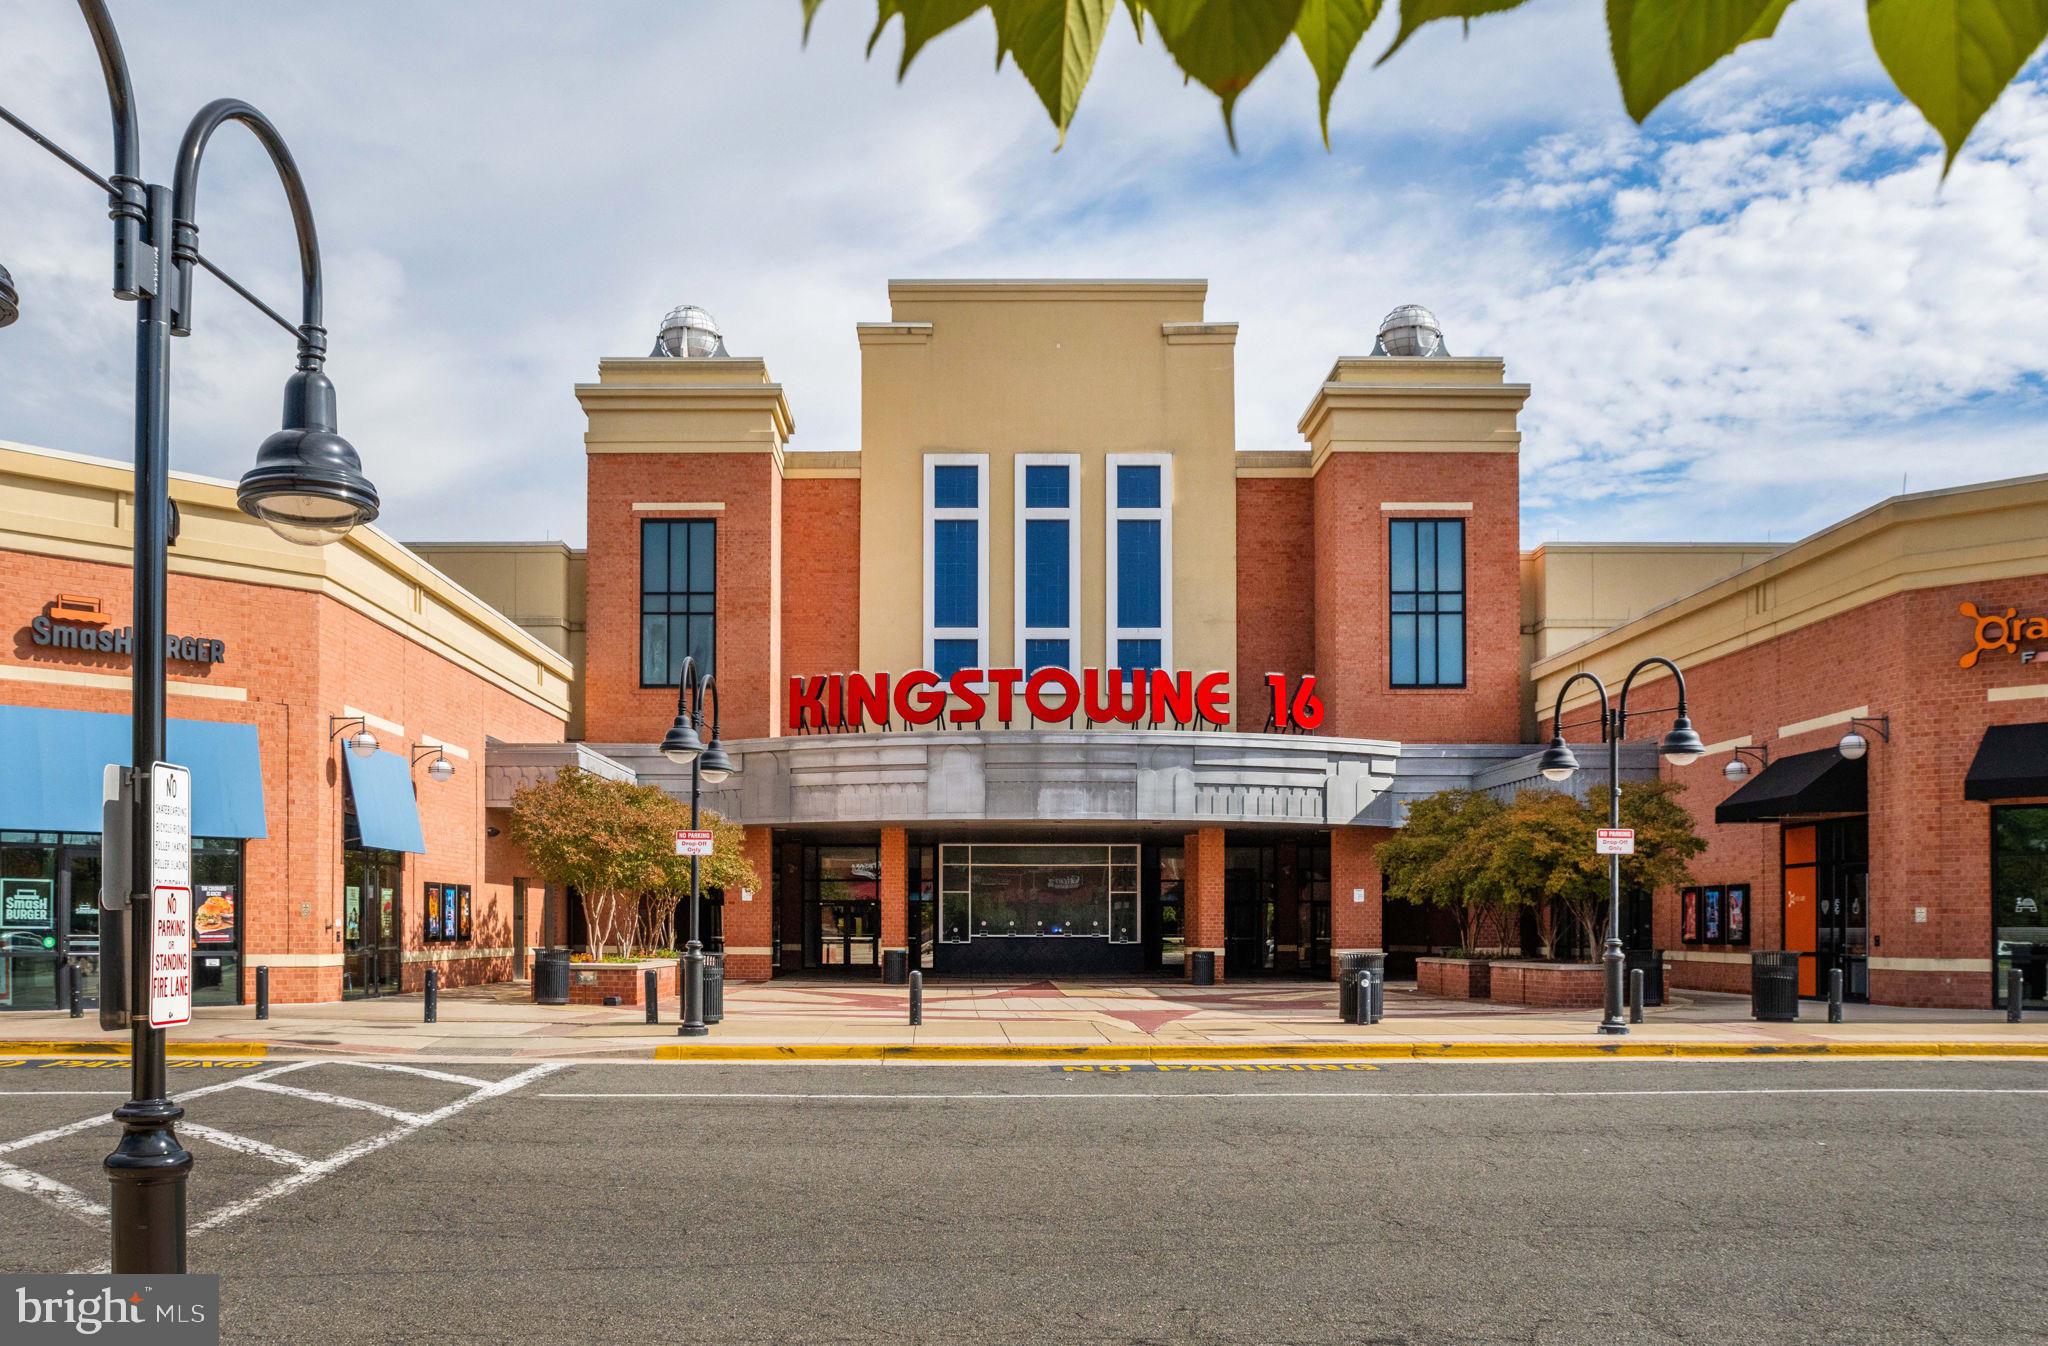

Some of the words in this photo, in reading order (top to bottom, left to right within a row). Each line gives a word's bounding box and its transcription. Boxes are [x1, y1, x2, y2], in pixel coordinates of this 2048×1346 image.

[789, 667, 1230, 729] KINGSTOWNE
[1265, 672, 1325, 730] 16
[166, 778, 177, 798] NO
[167, 897, 177, 914] NO
[5, 909, 48, 920] BURGER
[157, 920, 186, 937] PARKING
[168, 940, 175, 950] OR
[155, 953, 187, 972] STANDING
[153, 976, 169, 998] FIRE
[170, 975, 188, 997] LANE
[1061, 1064, 1132, 1073] NO
[1156, 1063, 1382, 1072] PARKING
